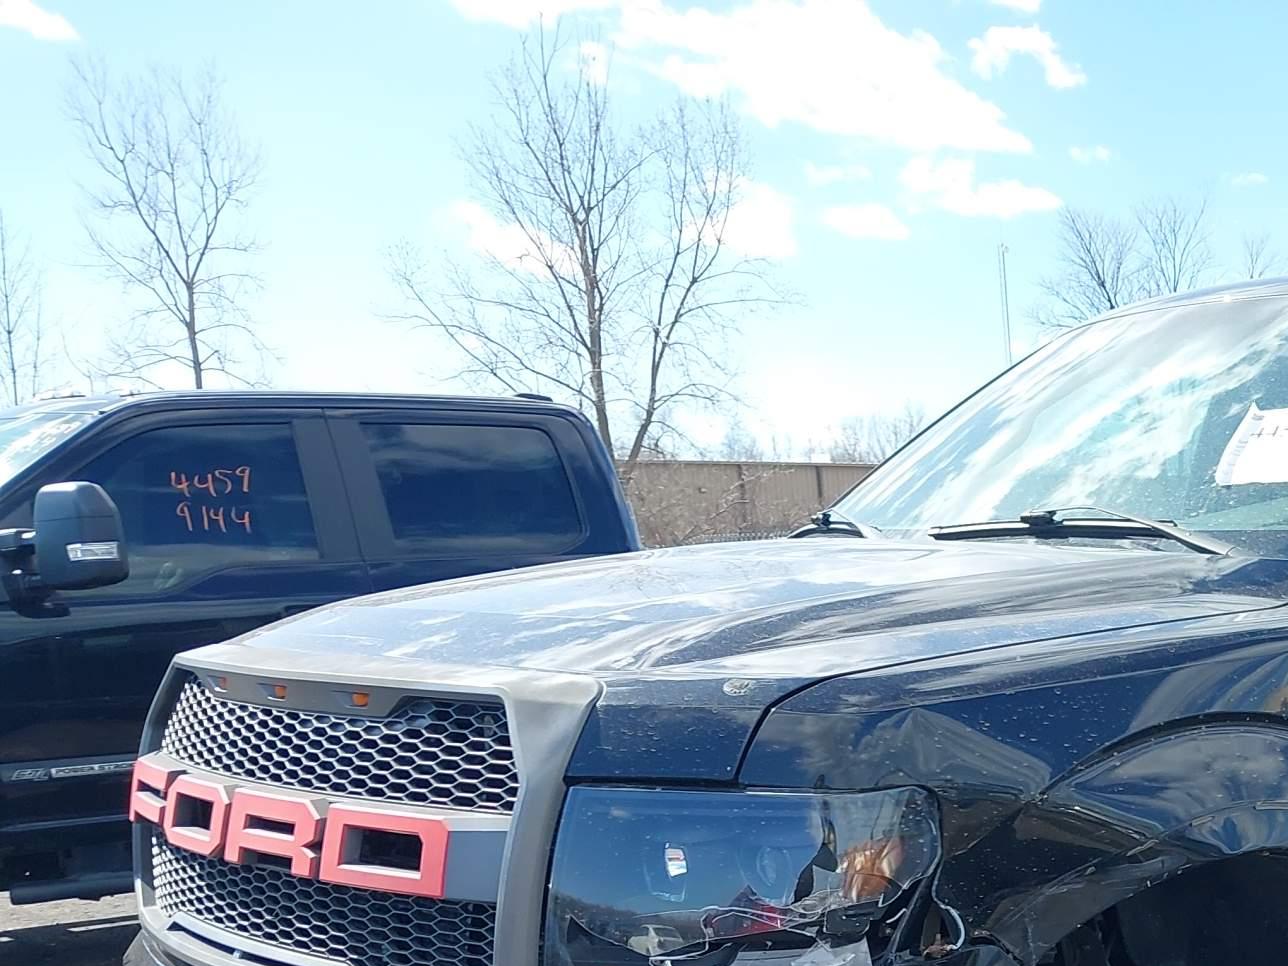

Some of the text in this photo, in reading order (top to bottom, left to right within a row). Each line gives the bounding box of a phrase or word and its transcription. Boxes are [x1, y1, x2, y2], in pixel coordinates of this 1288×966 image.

[170, 465, 251, 498] 4459
[175, 500, 252, 534] 9144
[128, 752, 449, 899] FORD
